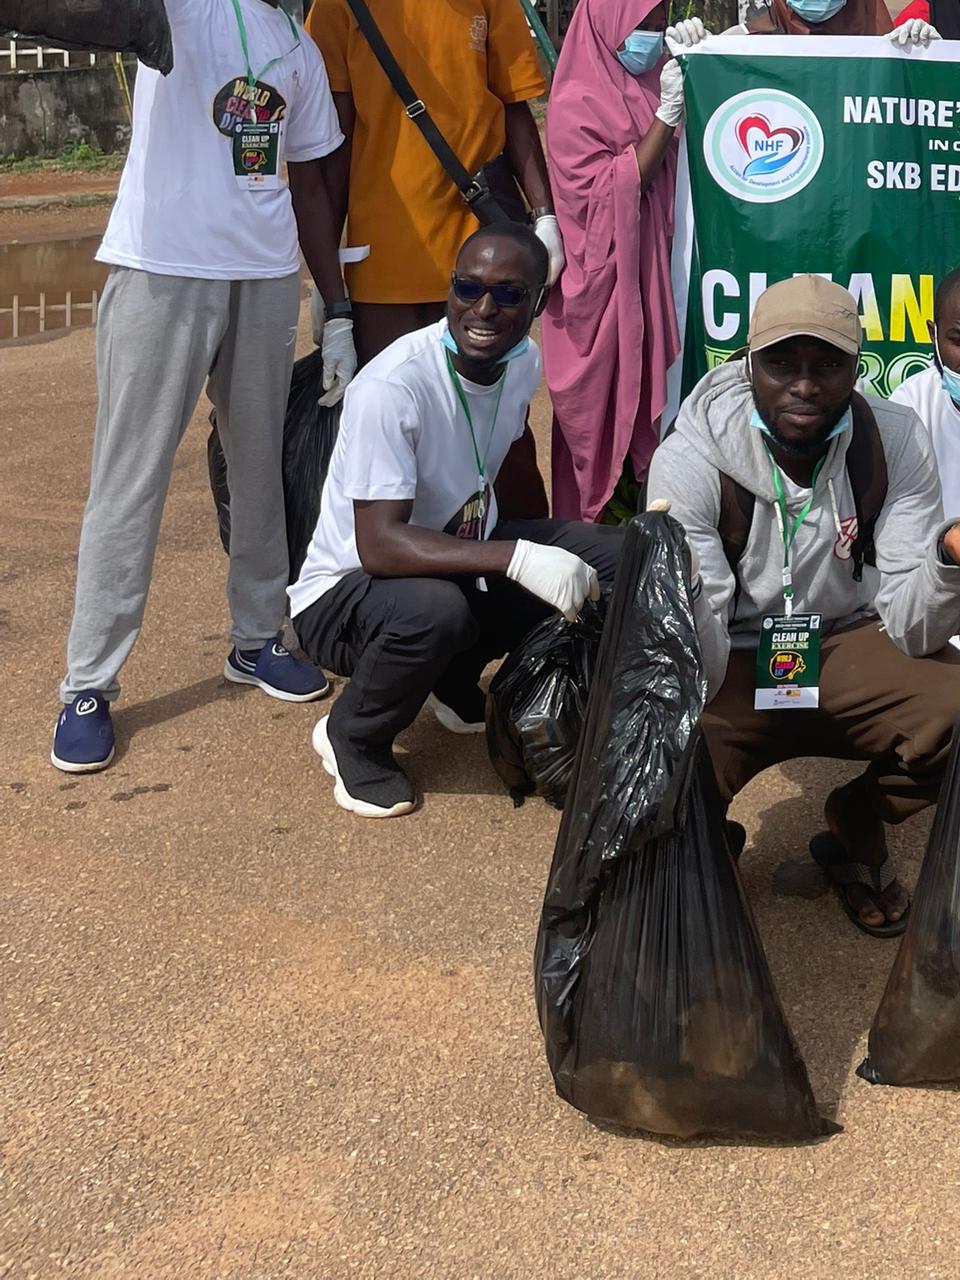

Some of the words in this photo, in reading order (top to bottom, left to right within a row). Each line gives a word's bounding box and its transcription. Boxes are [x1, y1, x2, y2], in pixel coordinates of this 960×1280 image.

[754, 139, 784, 152] NHF
[929, 139, 949, 151] IN
[866, 160, 922, 190] SKB
[702, 268, 935, 344] CAN
[772, 632, 797, 642] CLEAN
[798, 632, 810, 642] UP
